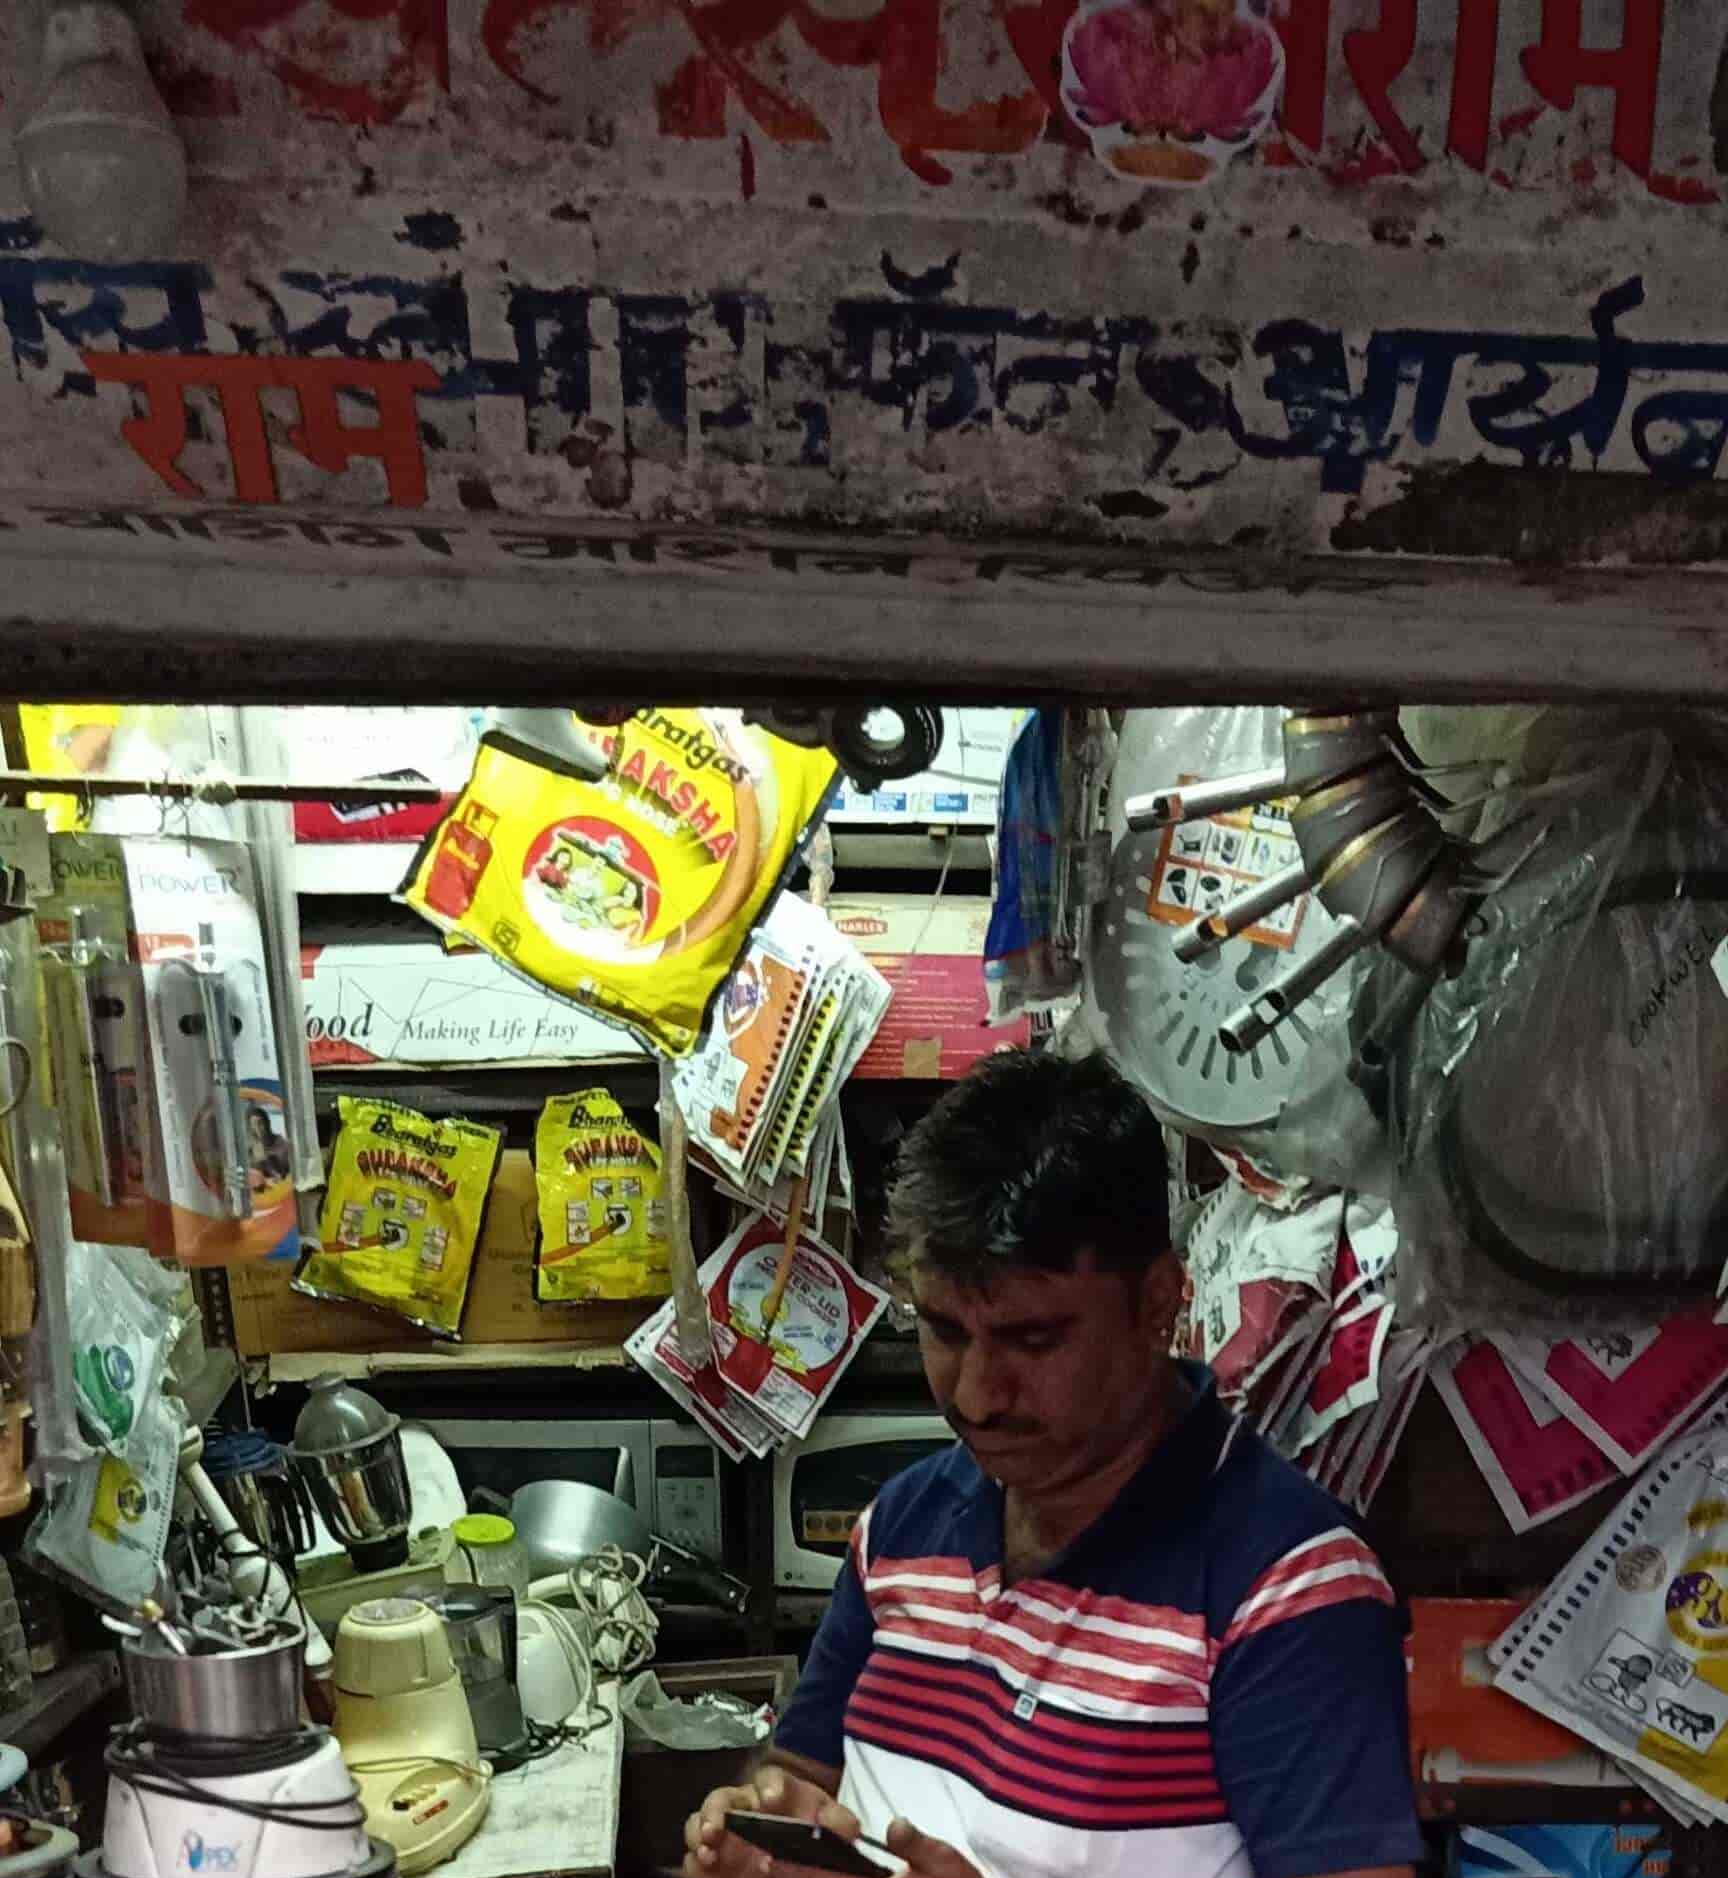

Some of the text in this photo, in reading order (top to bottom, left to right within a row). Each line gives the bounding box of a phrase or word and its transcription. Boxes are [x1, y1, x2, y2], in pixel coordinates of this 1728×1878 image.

[82, 353, 442, 508] राम
[303, 1002, 374, 1040] ood
[401, 1018, 579, 1047] Making Life Easy
